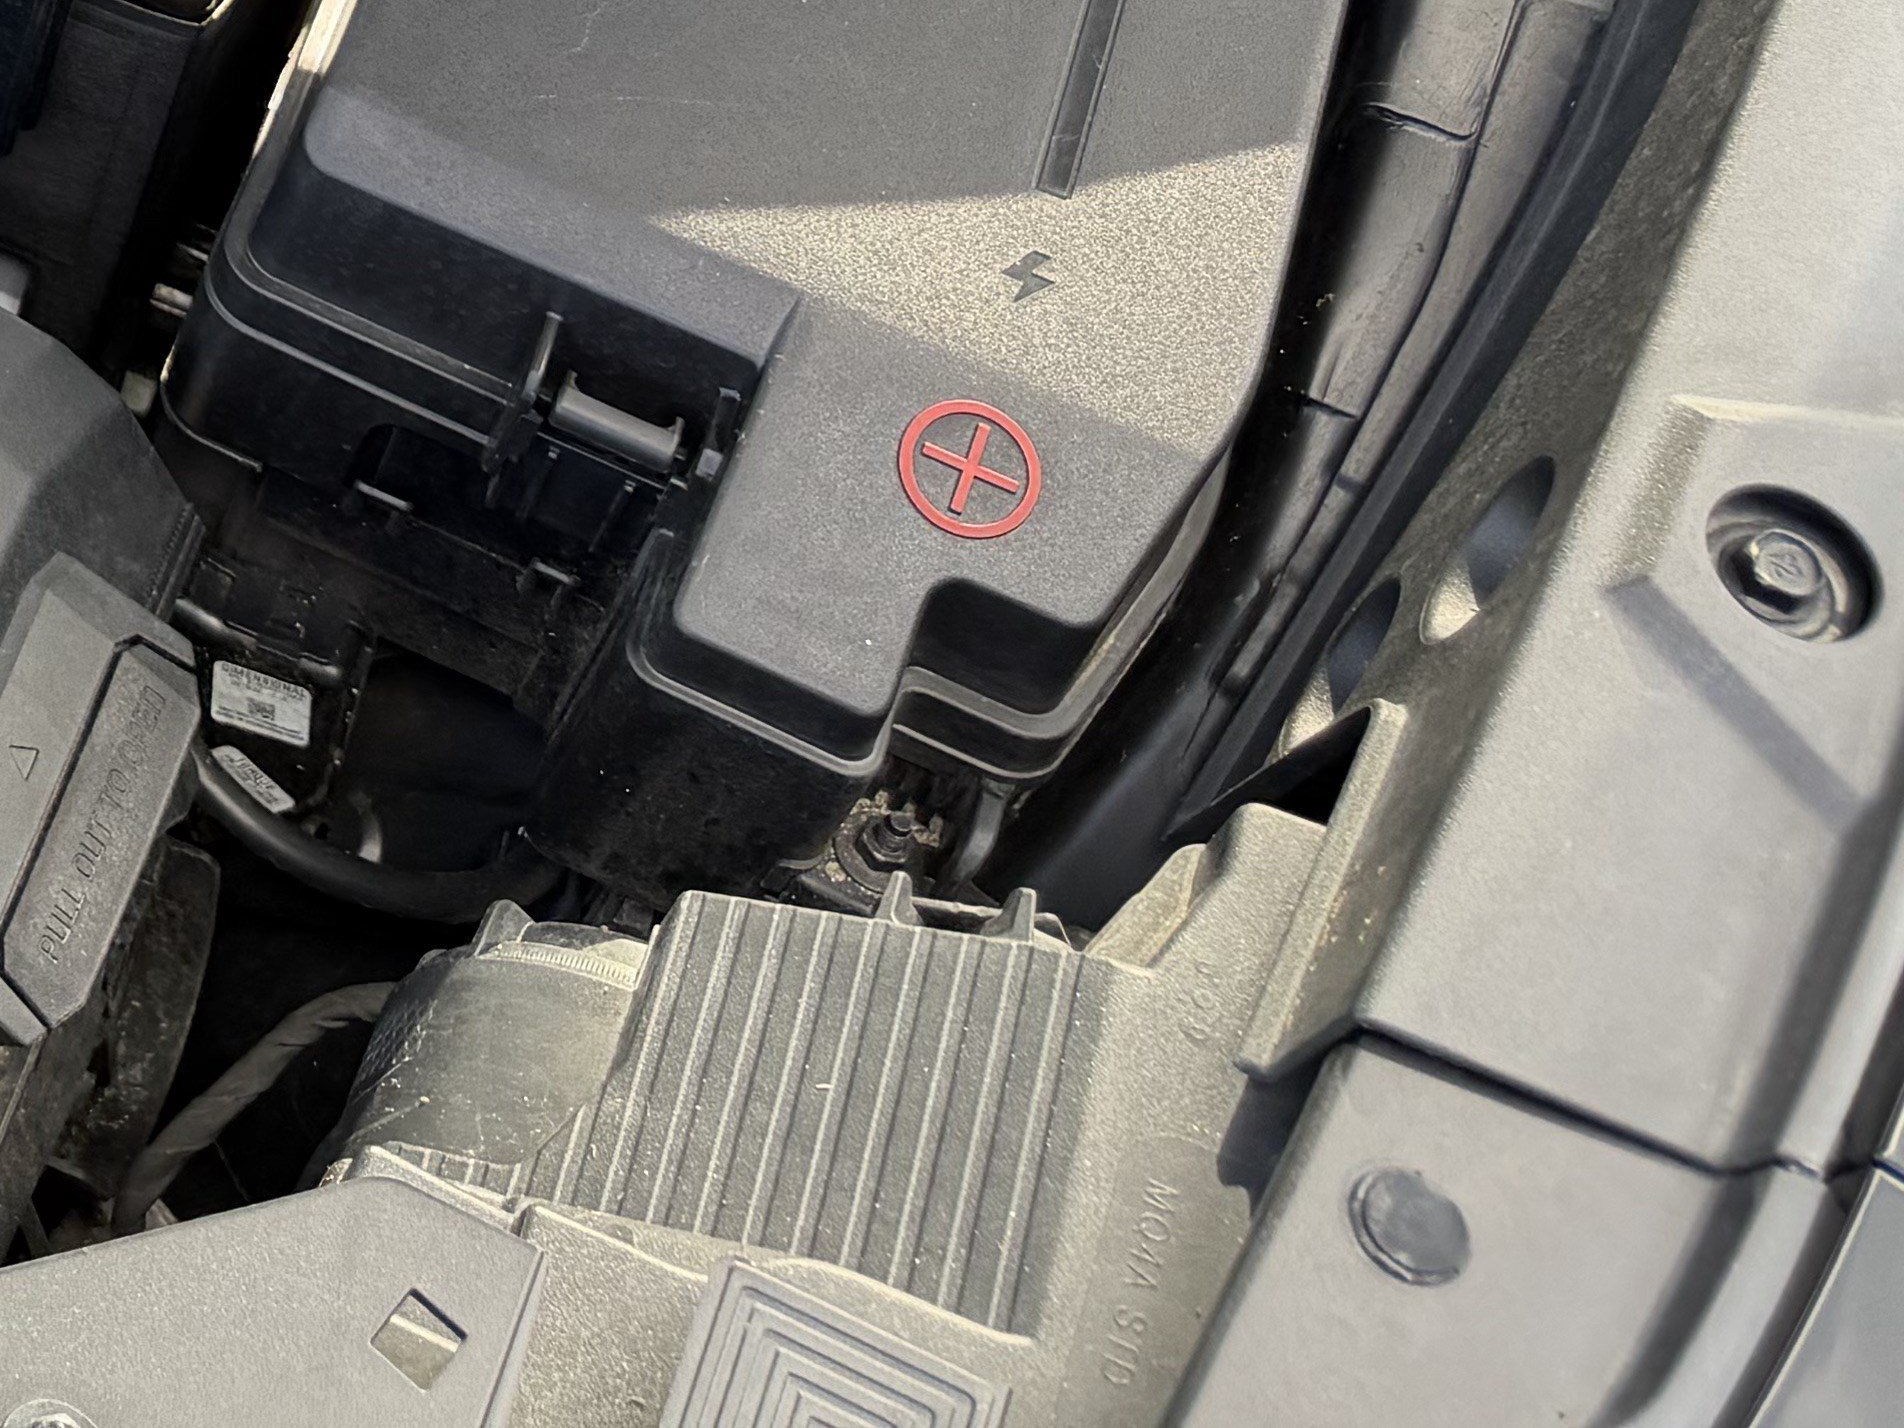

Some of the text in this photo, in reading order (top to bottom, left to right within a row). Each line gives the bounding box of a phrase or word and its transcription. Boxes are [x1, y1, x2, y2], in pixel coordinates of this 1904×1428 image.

[31, 684, 170, 964] PULL OUT TO OPEN
